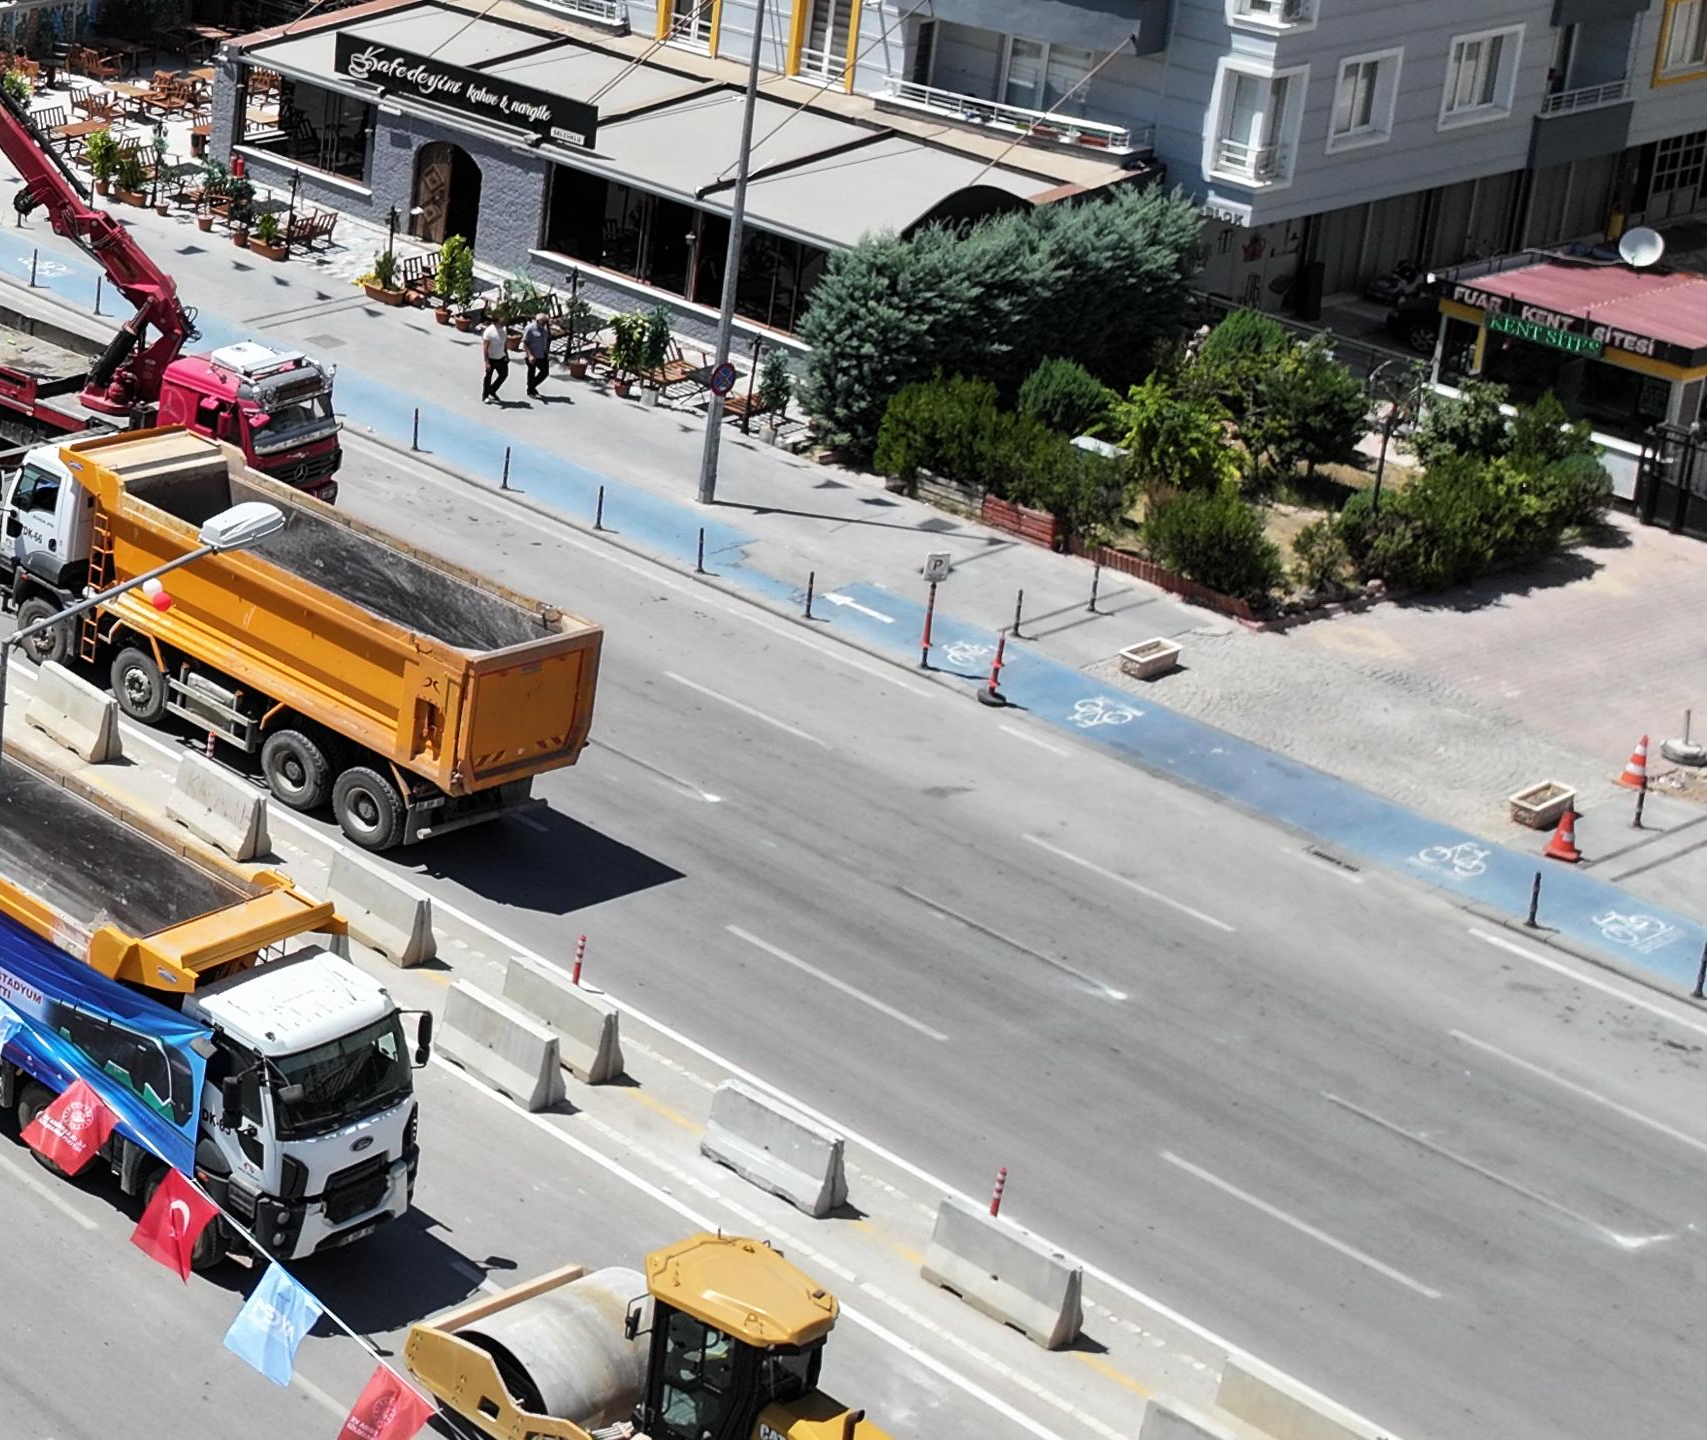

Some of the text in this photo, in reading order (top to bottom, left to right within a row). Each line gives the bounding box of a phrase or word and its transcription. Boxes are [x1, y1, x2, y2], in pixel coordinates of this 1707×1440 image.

[466, 83, 499, 107] kahve
[510, 97, 553, 122] nargile
[1453, 286, 1656, 356] FUAR KENT SİTESİ
